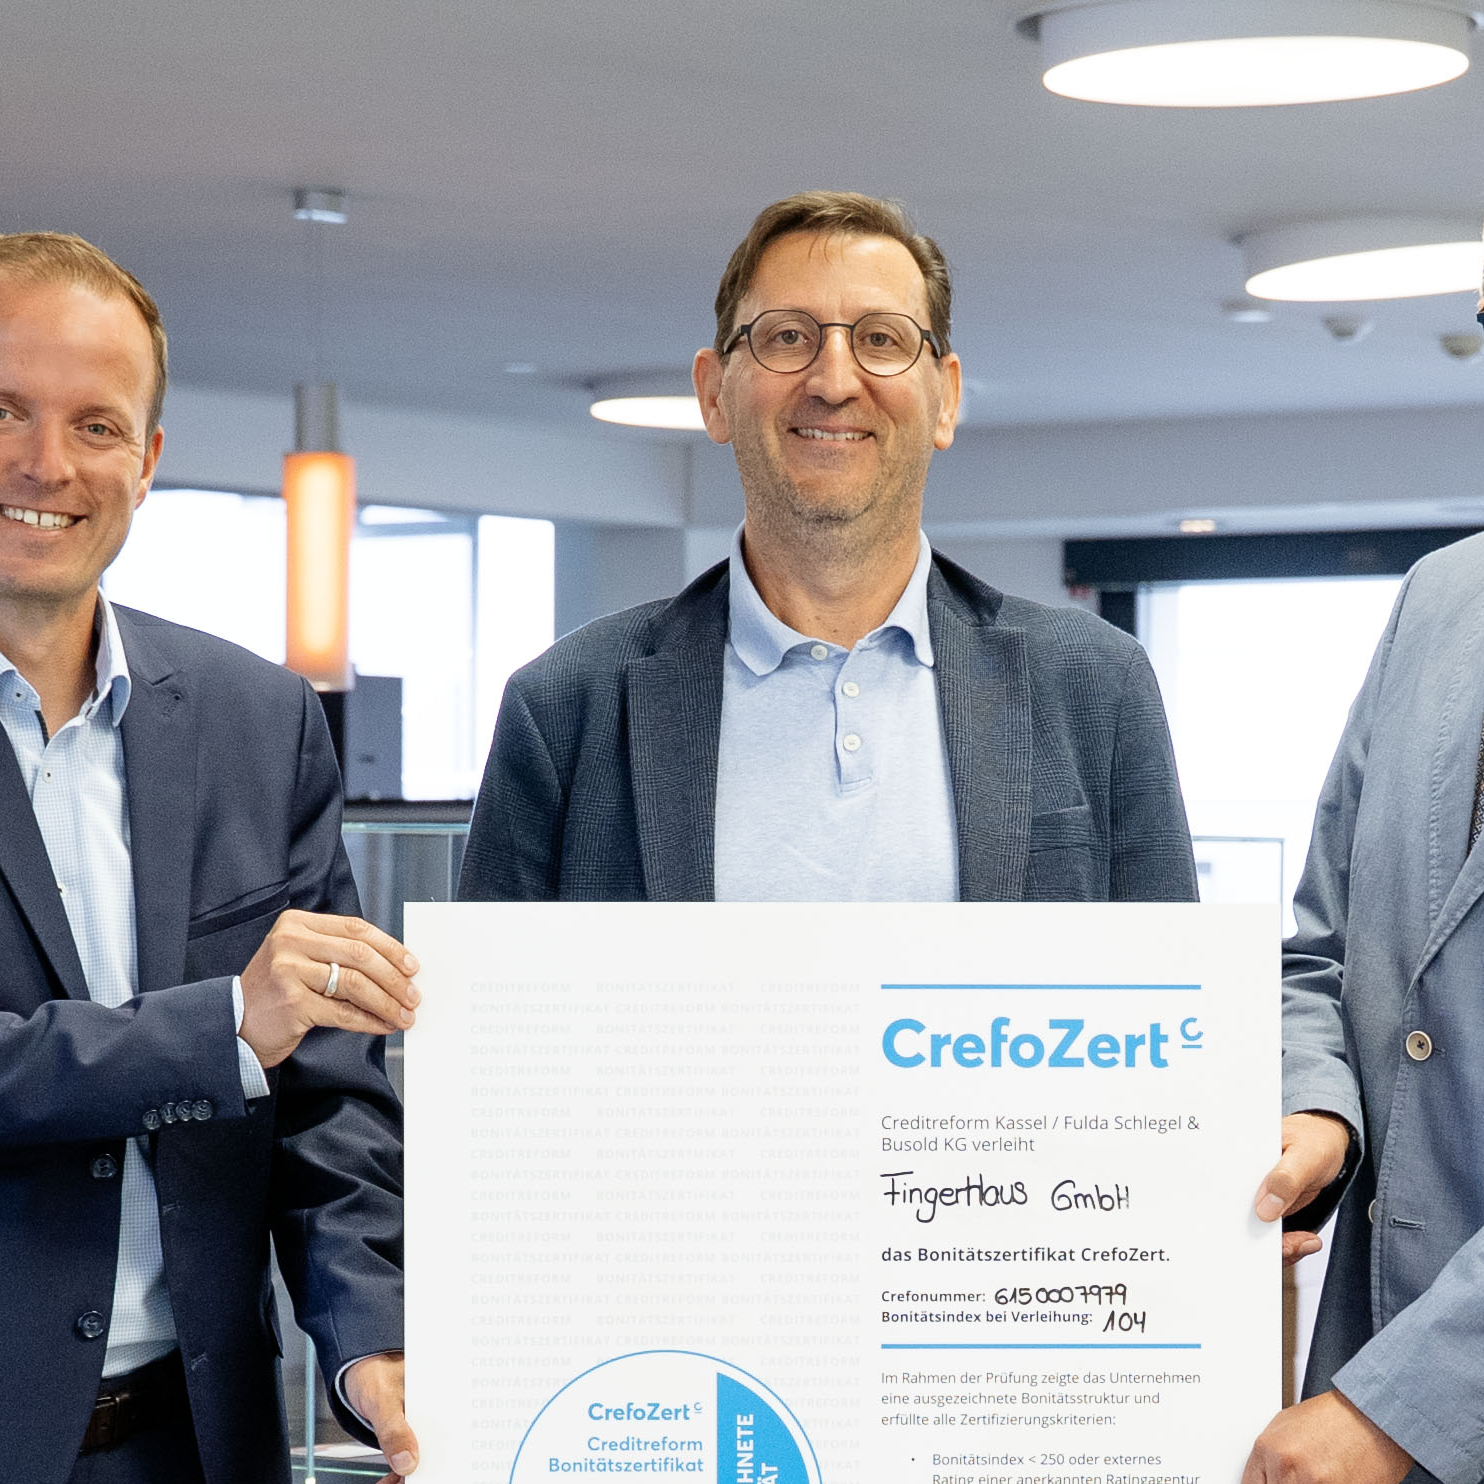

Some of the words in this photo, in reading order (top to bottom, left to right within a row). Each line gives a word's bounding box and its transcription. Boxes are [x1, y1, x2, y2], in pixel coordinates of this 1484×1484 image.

[881, 1015, 1170, 1070] CrefoZert
[881, 1112, 990, 1131] Creditreform
[995, 1114, 1048, 1131] Kassel
[1064, 1114, 1109, 1131] Fulda
[1113, 1114, 1182, 1135] Schlegel
[881, 1136, 939, 1152] Busold
[944, 1136, 968, 1152] KG
[971, 1135, 1036, 1153] verleiht
[879, 1170, 1029, 1224] FingerHaus
[1050, 1179, 1130, 1212] GmbH
[881, 1246, 912, 1262] das
[917, 1246, 1076, 1262] Bonitätszertifikat
[1080, 1246, 1170, 1262] CrefoZert.
[881, 1289, 986, 1303] Crefonummer:
[994, 1282, 1128, 1307] 6150007979
[881, 1310, 982, 1323] Bonitätsindex
[985, 1309, 1007, 1323] bei
[1010, 1309, 1093, 1326] Verleihung:
[1101, 1309, 1147, 1334] 104
[881, 1372, 898, 1385] Im
[902, 1371, 957, 1385] Rahmen
[959, 1371, 983, 1384] der
[985, 1371, 1039, 1388] Prüfung
[1040, 1371, 1080, 1388] zeigte
[1082, 1371, 1107, 1384] das
[1109, 1371, 1201, 1384] Unternehmen
[880, 1392, 910, 1405] eine
[913, 1392, 1018, 1408] ausgezeichnete
[1021, 1391, 1131, 1405] Bonitätsstruktur
[1134, 1391, 1160, 1405] und
[587, 1401, 691, 1422] CrefoZert
[881, 1412, 930, 1426] erfüllte
[932, 1412, 957, 1426] alle
[959, 1412, 1116, 1429] Zertifizierungskriterien:
[587, 1435, 703, 1452] Creditreform
[548, 1455, 704, 1473] Bonitätszertifikat
[932, 1452, 1025, 1466] Bonitätsindex
[1039, 1453, 1065, 1466] 250
[1068, 1452, 1101, 1466] oder
[1103, 1454, 1163, 1466] externes
